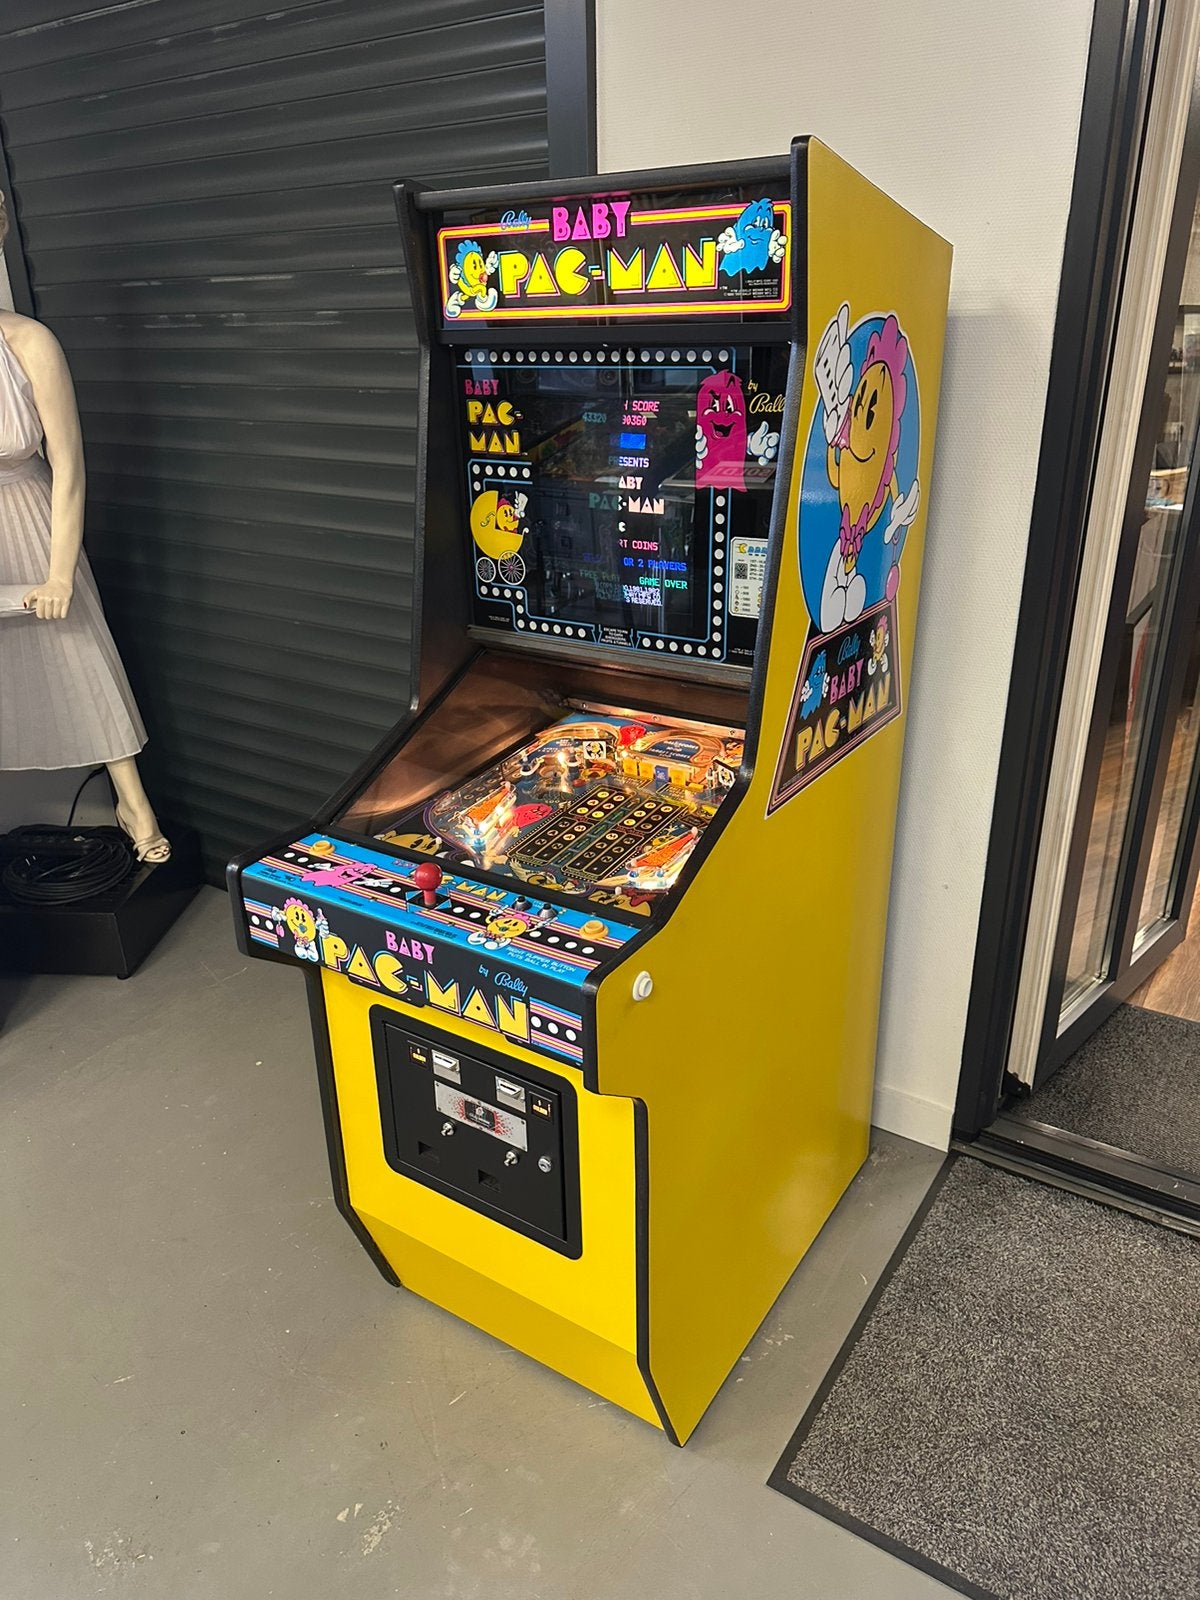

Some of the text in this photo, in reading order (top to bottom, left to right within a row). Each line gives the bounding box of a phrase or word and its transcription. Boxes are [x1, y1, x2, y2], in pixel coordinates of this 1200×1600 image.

[501, 210, 532, 231] Bally
[552, 201, 632, 242] BABY
[498, 237, 718, 298] PAC-MAN
[464, 379, 499, 396] BABY
[747, 379, 758, 393] by
[466, 399, 524, 426] PAC-
[632, 400, 660, 412] SCORE
[749, 393, 786, 414] Ball
[469, 430, 522, 455] MAN
[632, 540, 658, 551] COINS
[623, 557, 687, 572] OR 2 PLAYERS
[639, 576, 688, 590] GAME OVER
[837, 632, 861, 665] Bally
[829, 658, 865, 705] BABY
[795, 671, 891, 772] PAC-MAN
[385, 930, 435, 965] BABY
[321, 933, 530, 1043] PAC-MAN
[477, 964, 529, 997] by Bally
